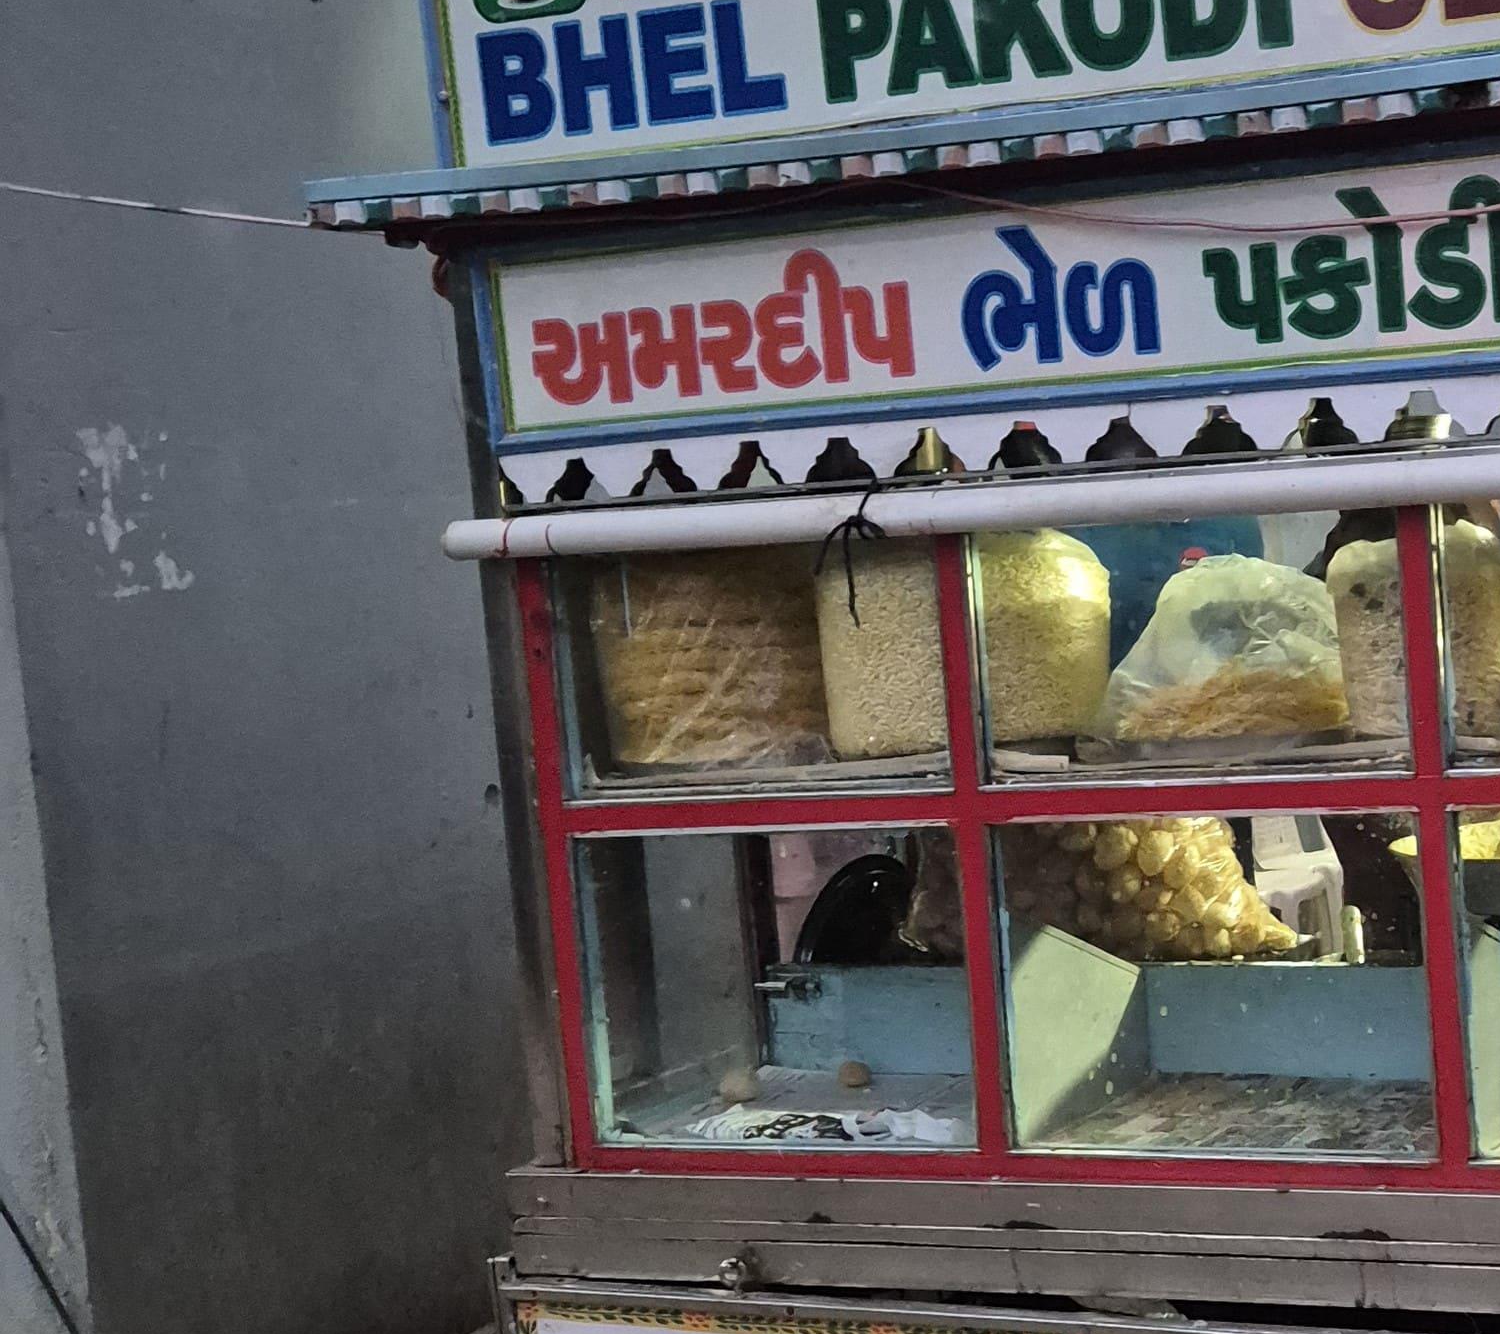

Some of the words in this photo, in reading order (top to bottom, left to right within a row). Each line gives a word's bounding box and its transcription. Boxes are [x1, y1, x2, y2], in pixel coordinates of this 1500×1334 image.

[476, 0, 788, 146] BHEL
[531, 247, 916, 407] અમરદીપ
[961, 225, 1163, 372] ભેળ
